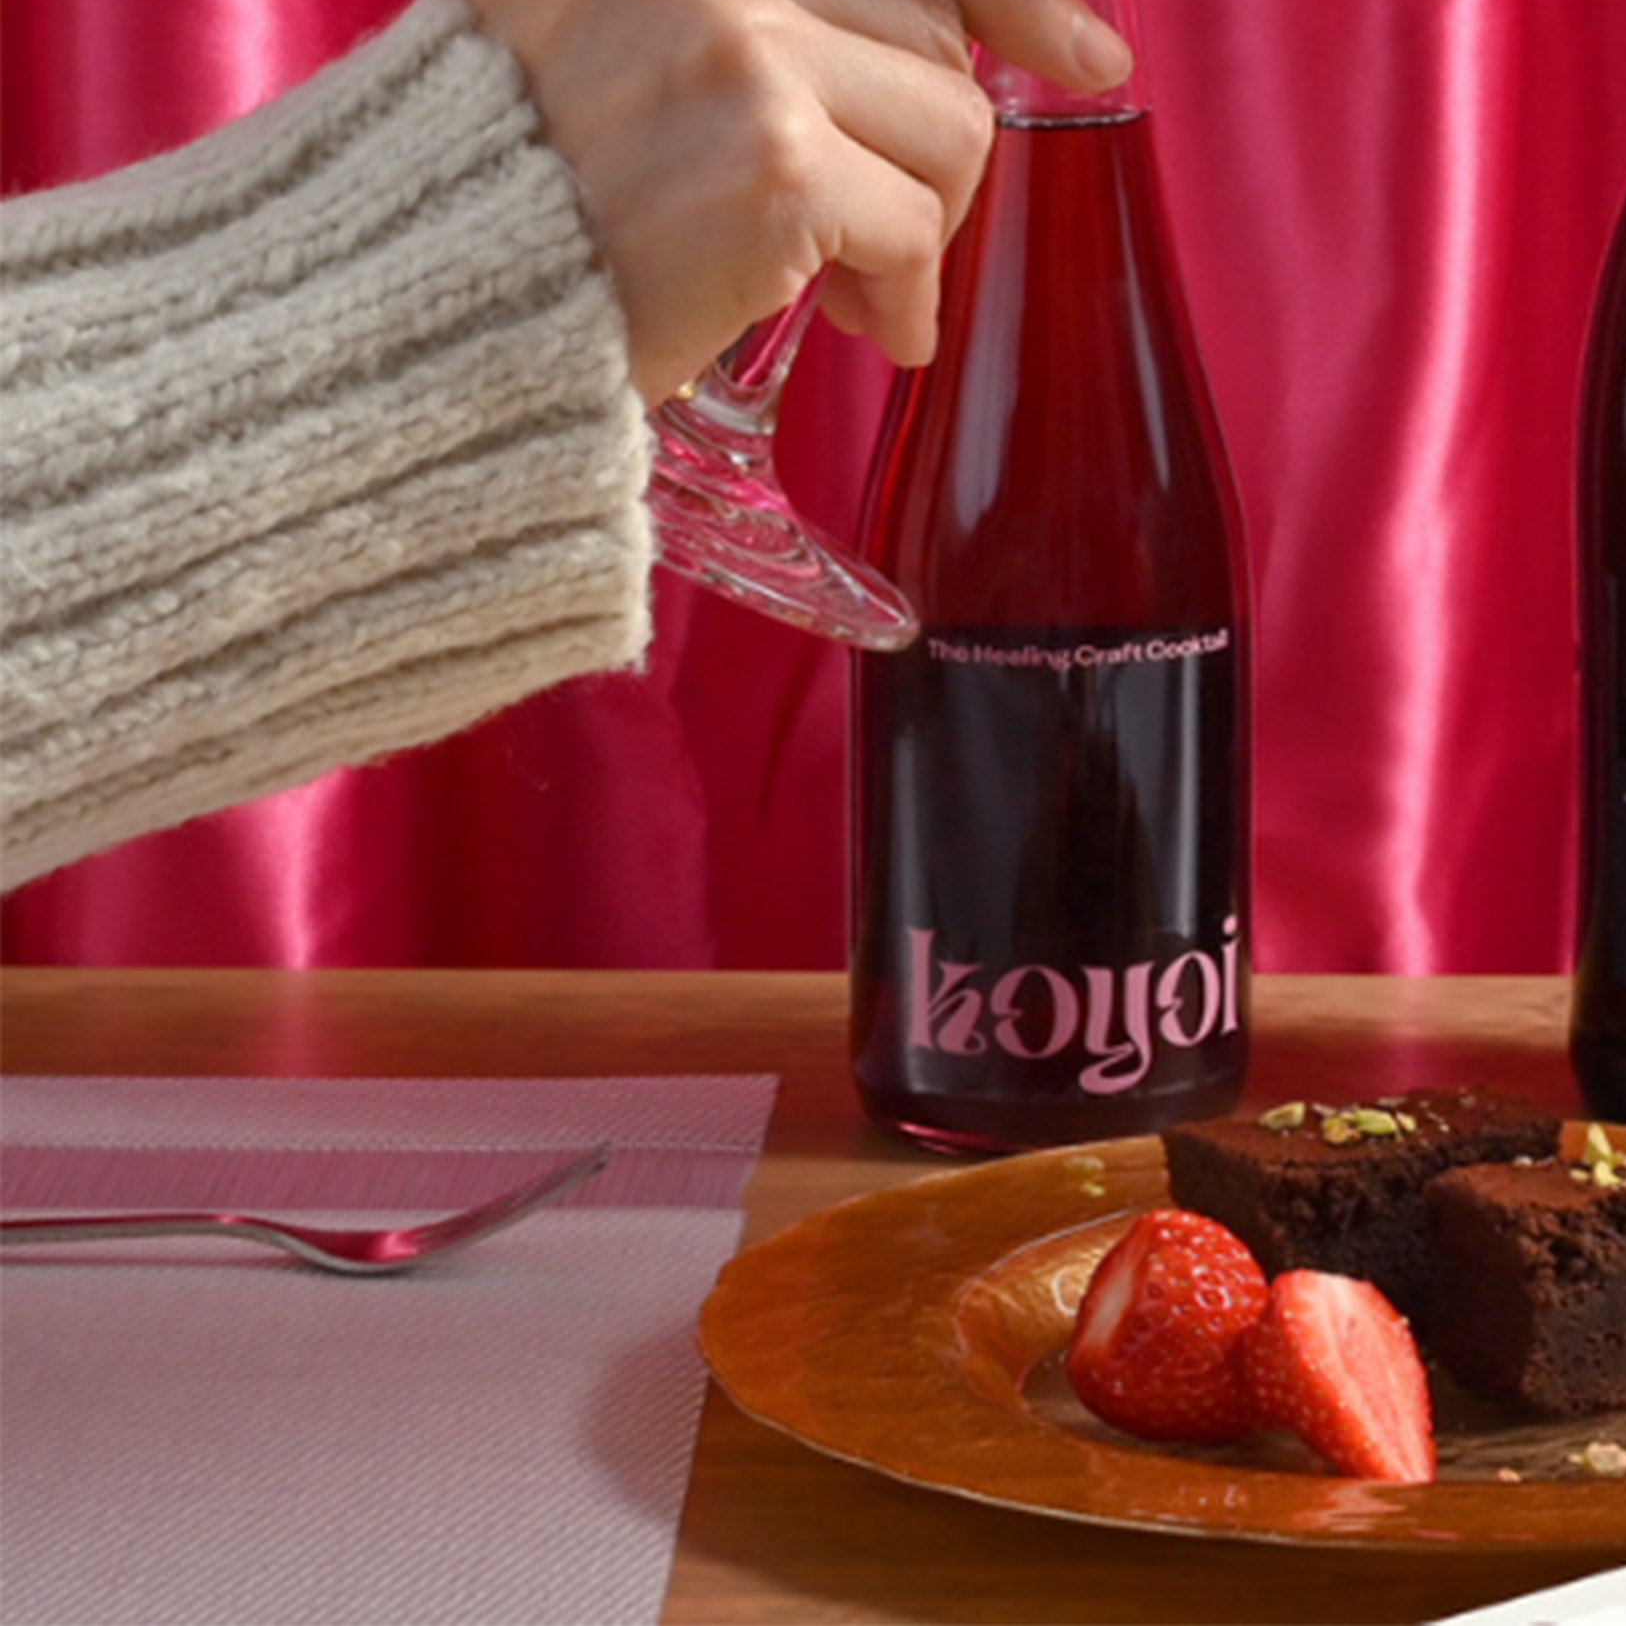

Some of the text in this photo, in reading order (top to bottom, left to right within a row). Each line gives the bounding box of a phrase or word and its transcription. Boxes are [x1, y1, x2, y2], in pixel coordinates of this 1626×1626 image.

[928, 638, 968, 663] The
[973, 644, 1072, 672] Healing
[1074, 644, 1143, 667] Craft
[907, 914, 1240, 1094] koyoi
